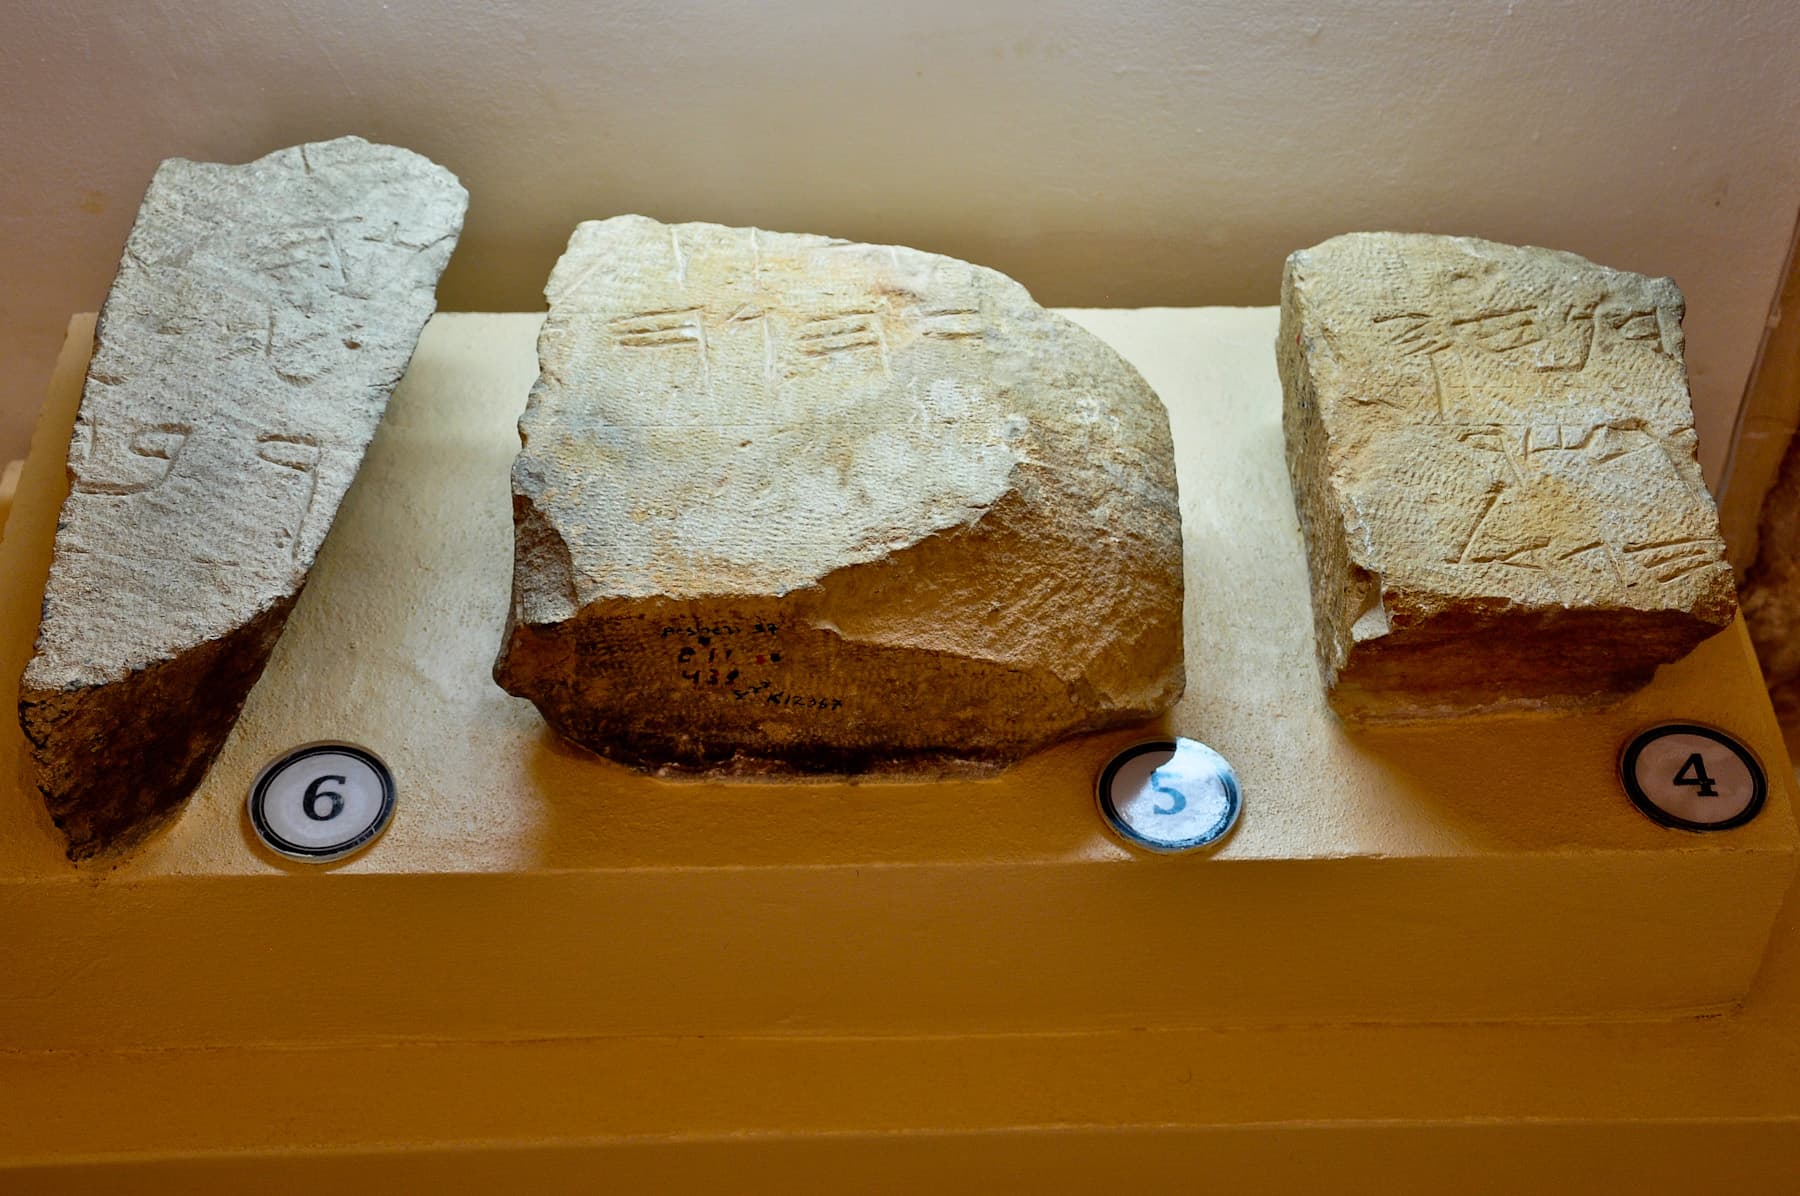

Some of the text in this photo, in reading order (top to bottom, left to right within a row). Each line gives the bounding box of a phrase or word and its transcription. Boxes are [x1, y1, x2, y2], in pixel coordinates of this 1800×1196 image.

[1150, 771, 1187, 815] 5
[1672, 752, 1719, 797] 4
[302, 774, 347, 821] 6
